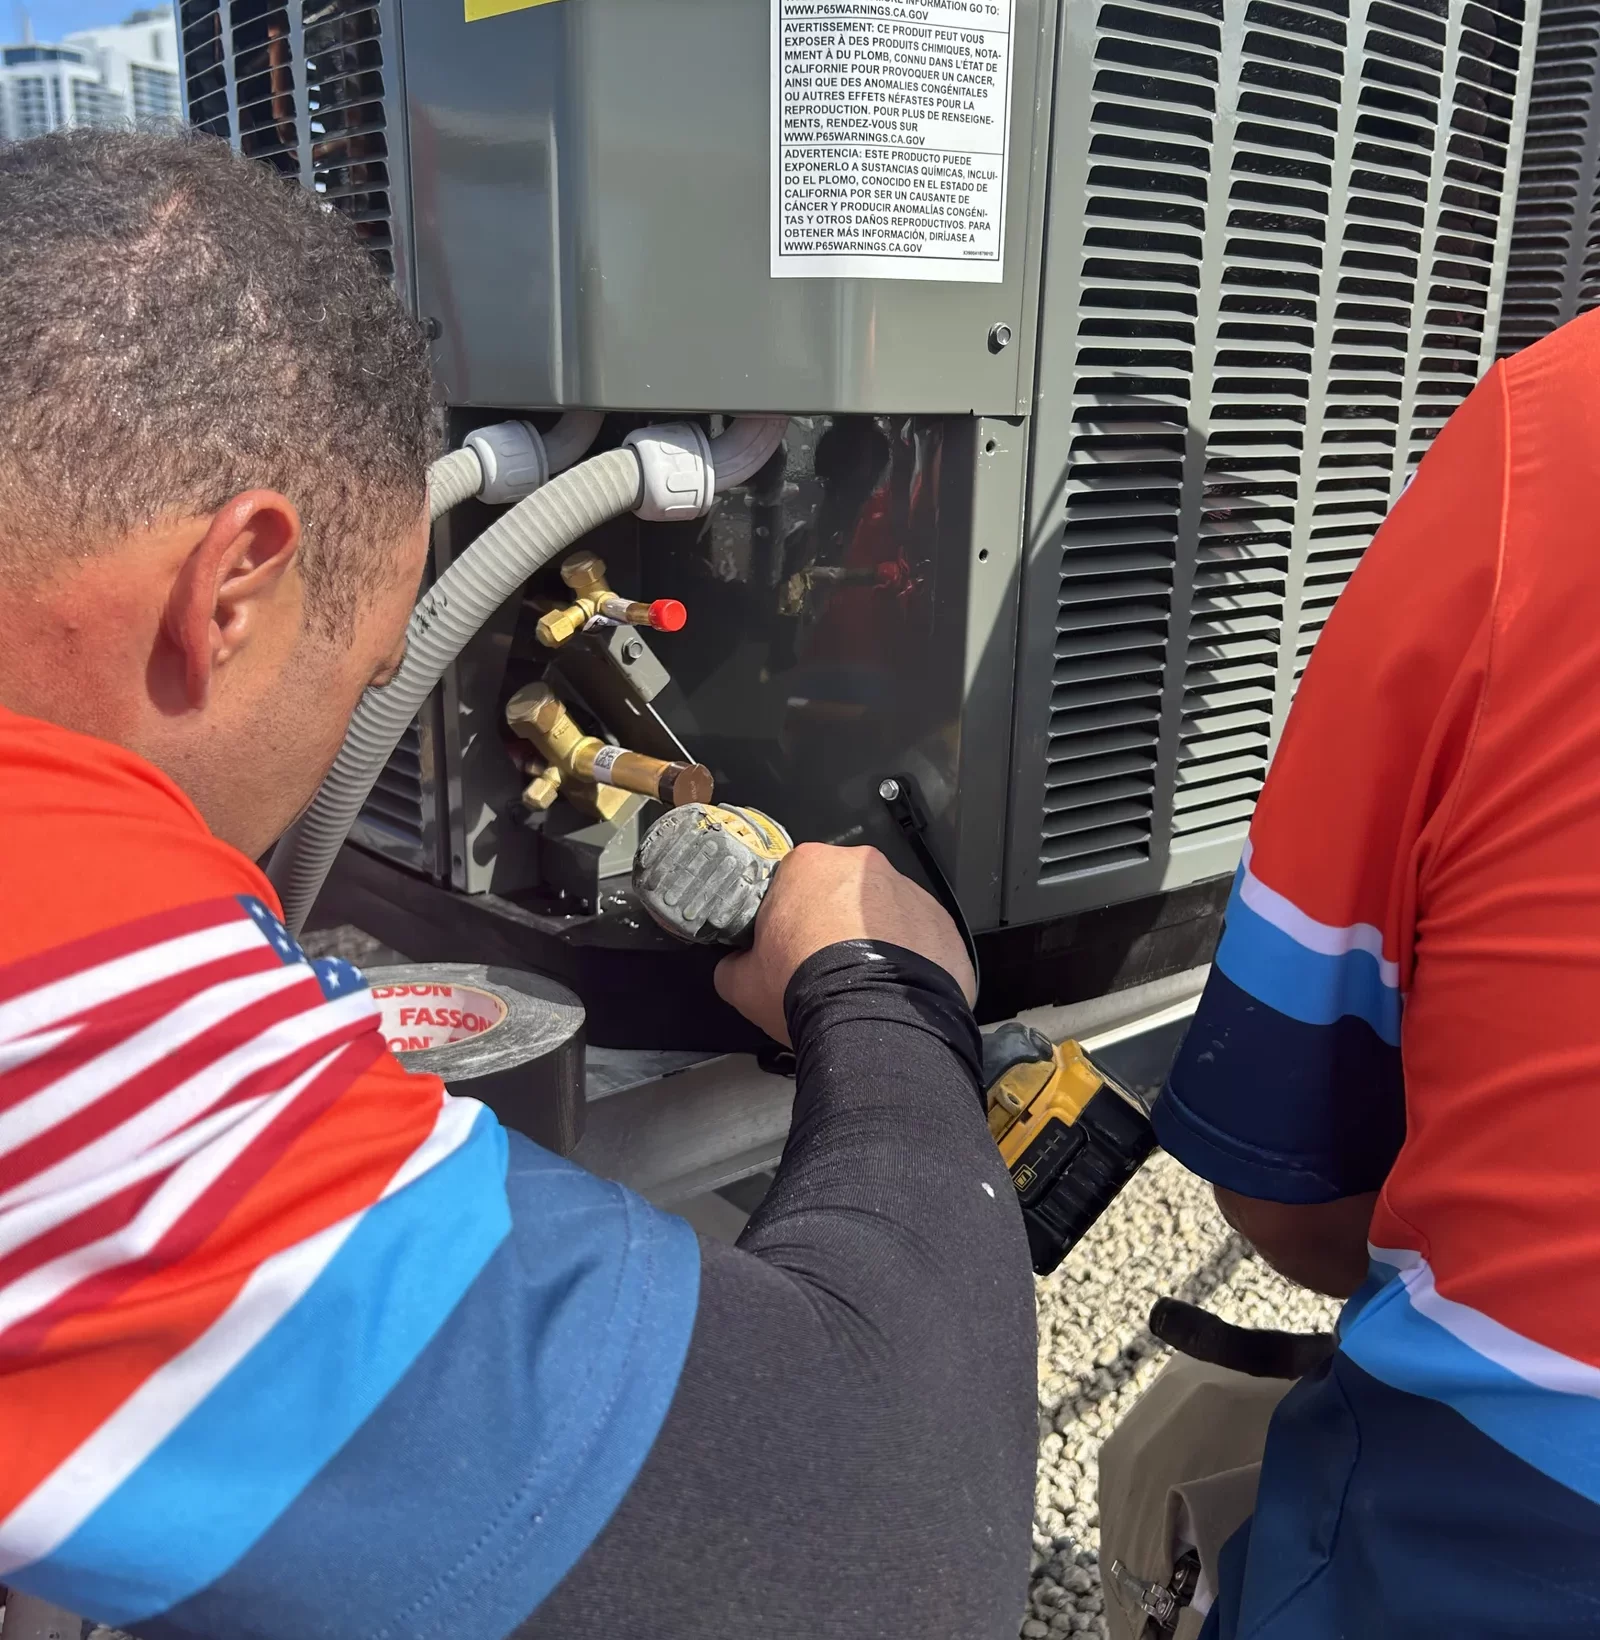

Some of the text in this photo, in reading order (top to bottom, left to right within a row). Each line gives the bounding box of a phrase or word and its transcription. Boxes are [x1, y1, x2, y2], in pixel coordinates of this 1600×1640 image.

[785, 4, 929, 20] WWW.P65WARNINGS.CA.GOV
[969, 3, 983, 13] GO
[985, 5, 999, 15] TO:
[785, 22, 984, 44] AVERTISSEMENT: CE PRODUIT PEUT VOUS
[785, 33, 1001, 59] EXPOSER À DES PRODUITS CHIMIQUES, NOTA-
[785, 47, 997, 72] MMENT À DU PLOMB, CONNU DANS L'ÉTAT DE
[785, 63, 995, 87] CALIFORNIE POUR PROVOQUER UN CANCER,
[785, 77, 988, 98] AINSI QUE DES ANOMALIES CONGÉNITALES
[785, 91, 975, 110] OU AUTRES EFFETS NÉFASTES POUR LA
[785, 104, 994, 125] REPRODUCTION. POUR PLUS DE RENSEIGNE-
[785, 118, 918, 132] MENTS, RENDEZ-VOUS SUR
[785, 131, 925, 145] WWW.P65WARNINGS.CA.GOV
[785, 148, 971, 166] ADVERTENCIA: ESTE PRODUCTO PUEDE
[785, 162, 998, 180] EXPONERLO A SUSTANCIAS QUÍMICAS, INCLUI-
[785, 175, 988, 192] DO EL PLOMO, CONOCIDO EN EL ESTADO DE
[785, 188, 970, 204] CALIFORNIA POR SER UN CAUSANTE DE
[785, 200, 988, 217] CÁNCER Y PRODUCIR ANOMALÍAS CONGÉNI-
[785, 214, 991, 230] TAS Y OTROS DAÑOS REPRODUCTIVOS. PARA
[785, 226, 975, 242] OBTENER MÁS INFORMACIÓN, DIRÍJASE A
[785, 241, 922, 253] WWW.P65WARNINGS.CA.GOV
[400, 1007, 492, 1032] FASSON
